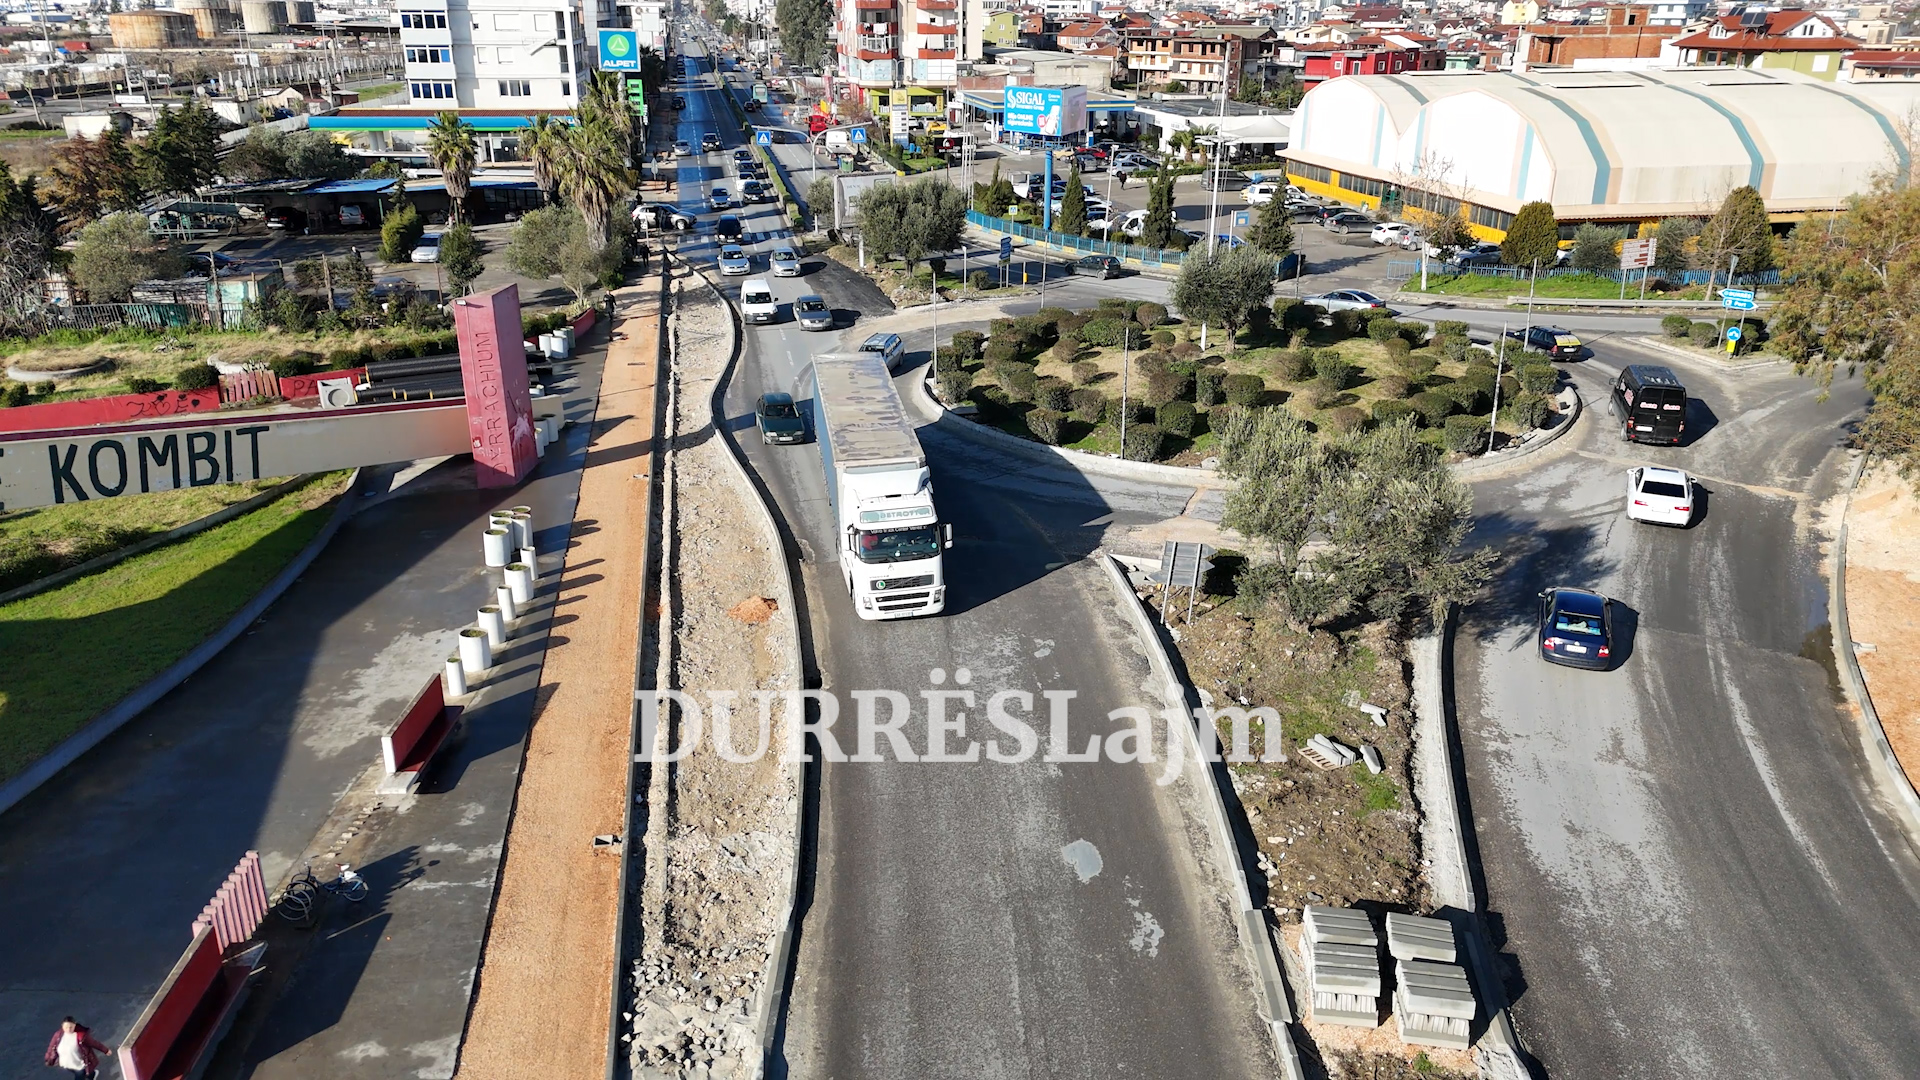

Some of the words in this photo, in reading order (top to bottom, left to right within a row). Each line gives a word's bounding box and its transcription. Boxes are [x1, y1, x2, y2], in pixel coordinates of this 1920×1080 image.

[1016, 91, 1045, 105] SIGAL
[474, 331, 508, 477] DYRRACHIUM
[48, 426, 270, 504] KOMBIT
